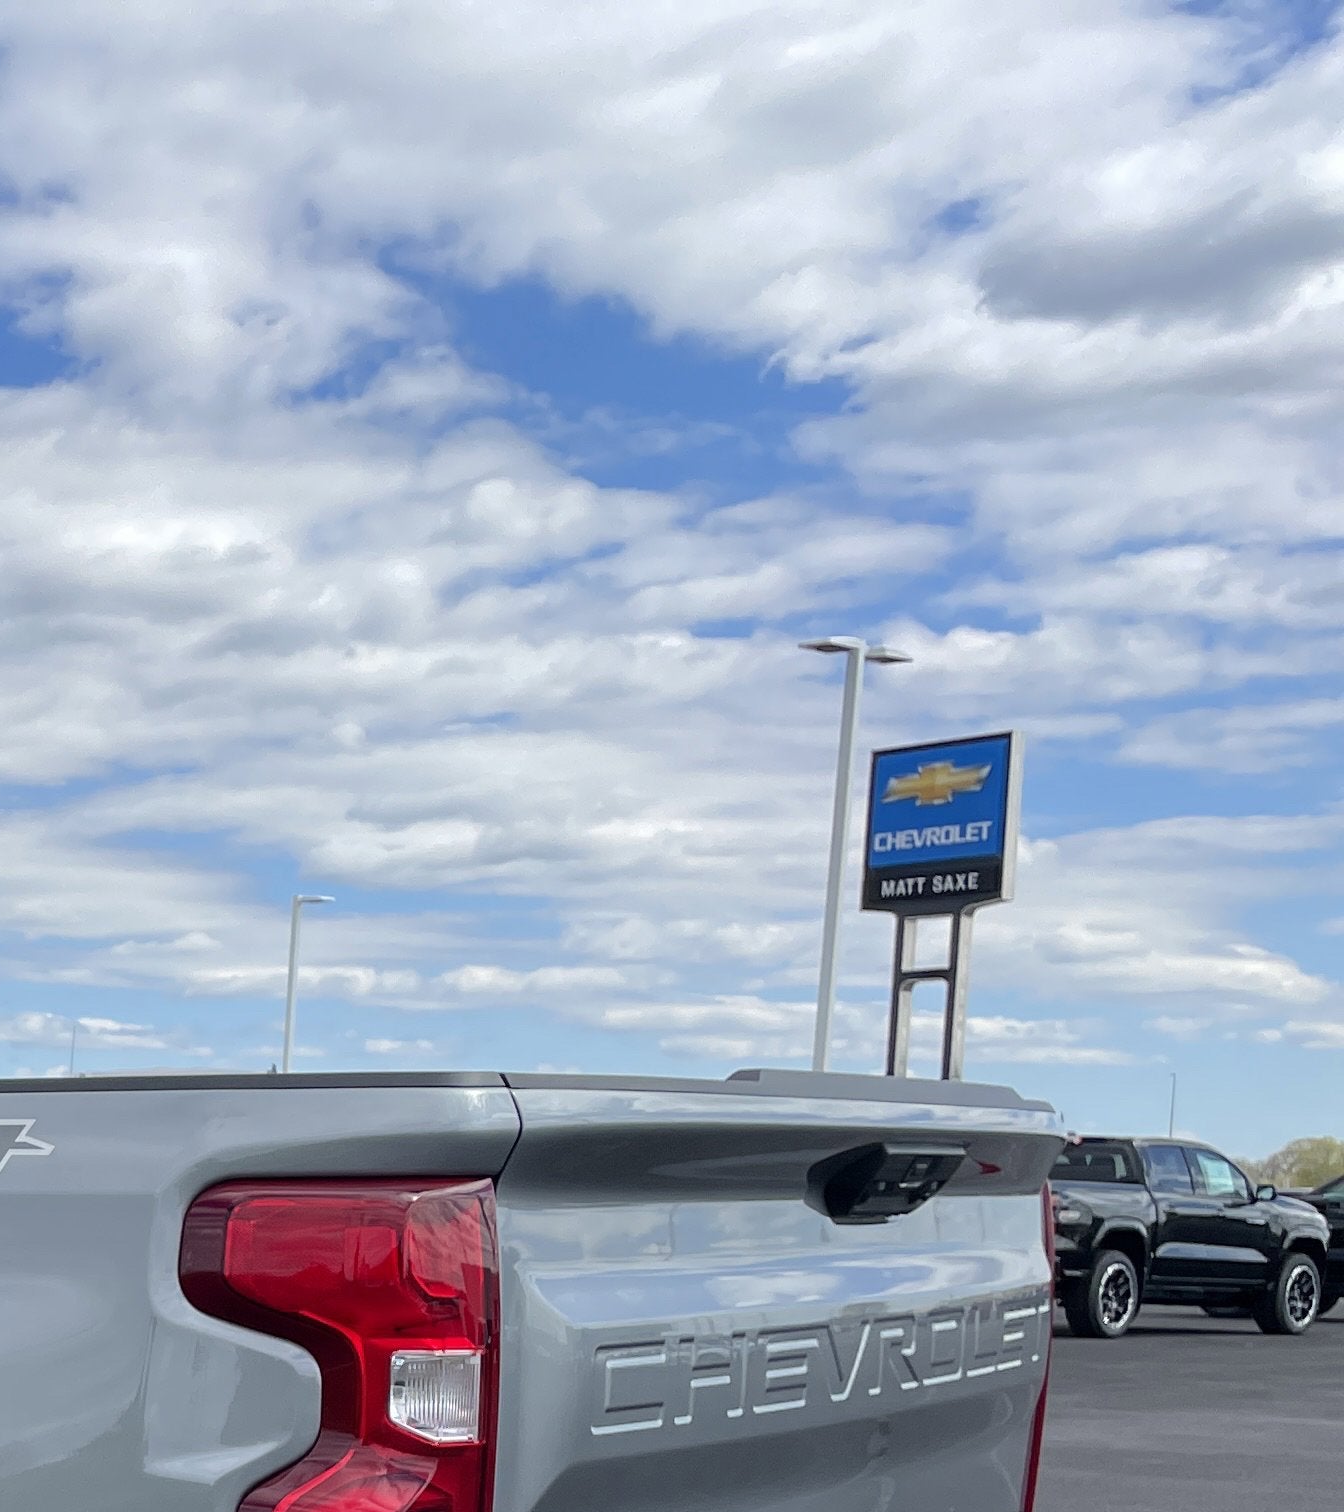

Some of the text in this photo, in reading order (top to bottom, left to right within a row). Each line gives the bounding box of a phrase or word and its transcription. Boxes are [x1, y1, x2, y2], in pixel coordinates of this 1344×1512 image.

[874, 821, 992, 852] CHEVROLET
[880, 871, 979, 898] MATT SAXE
[590, 1303, 1050, 1435] CHEVROLET
